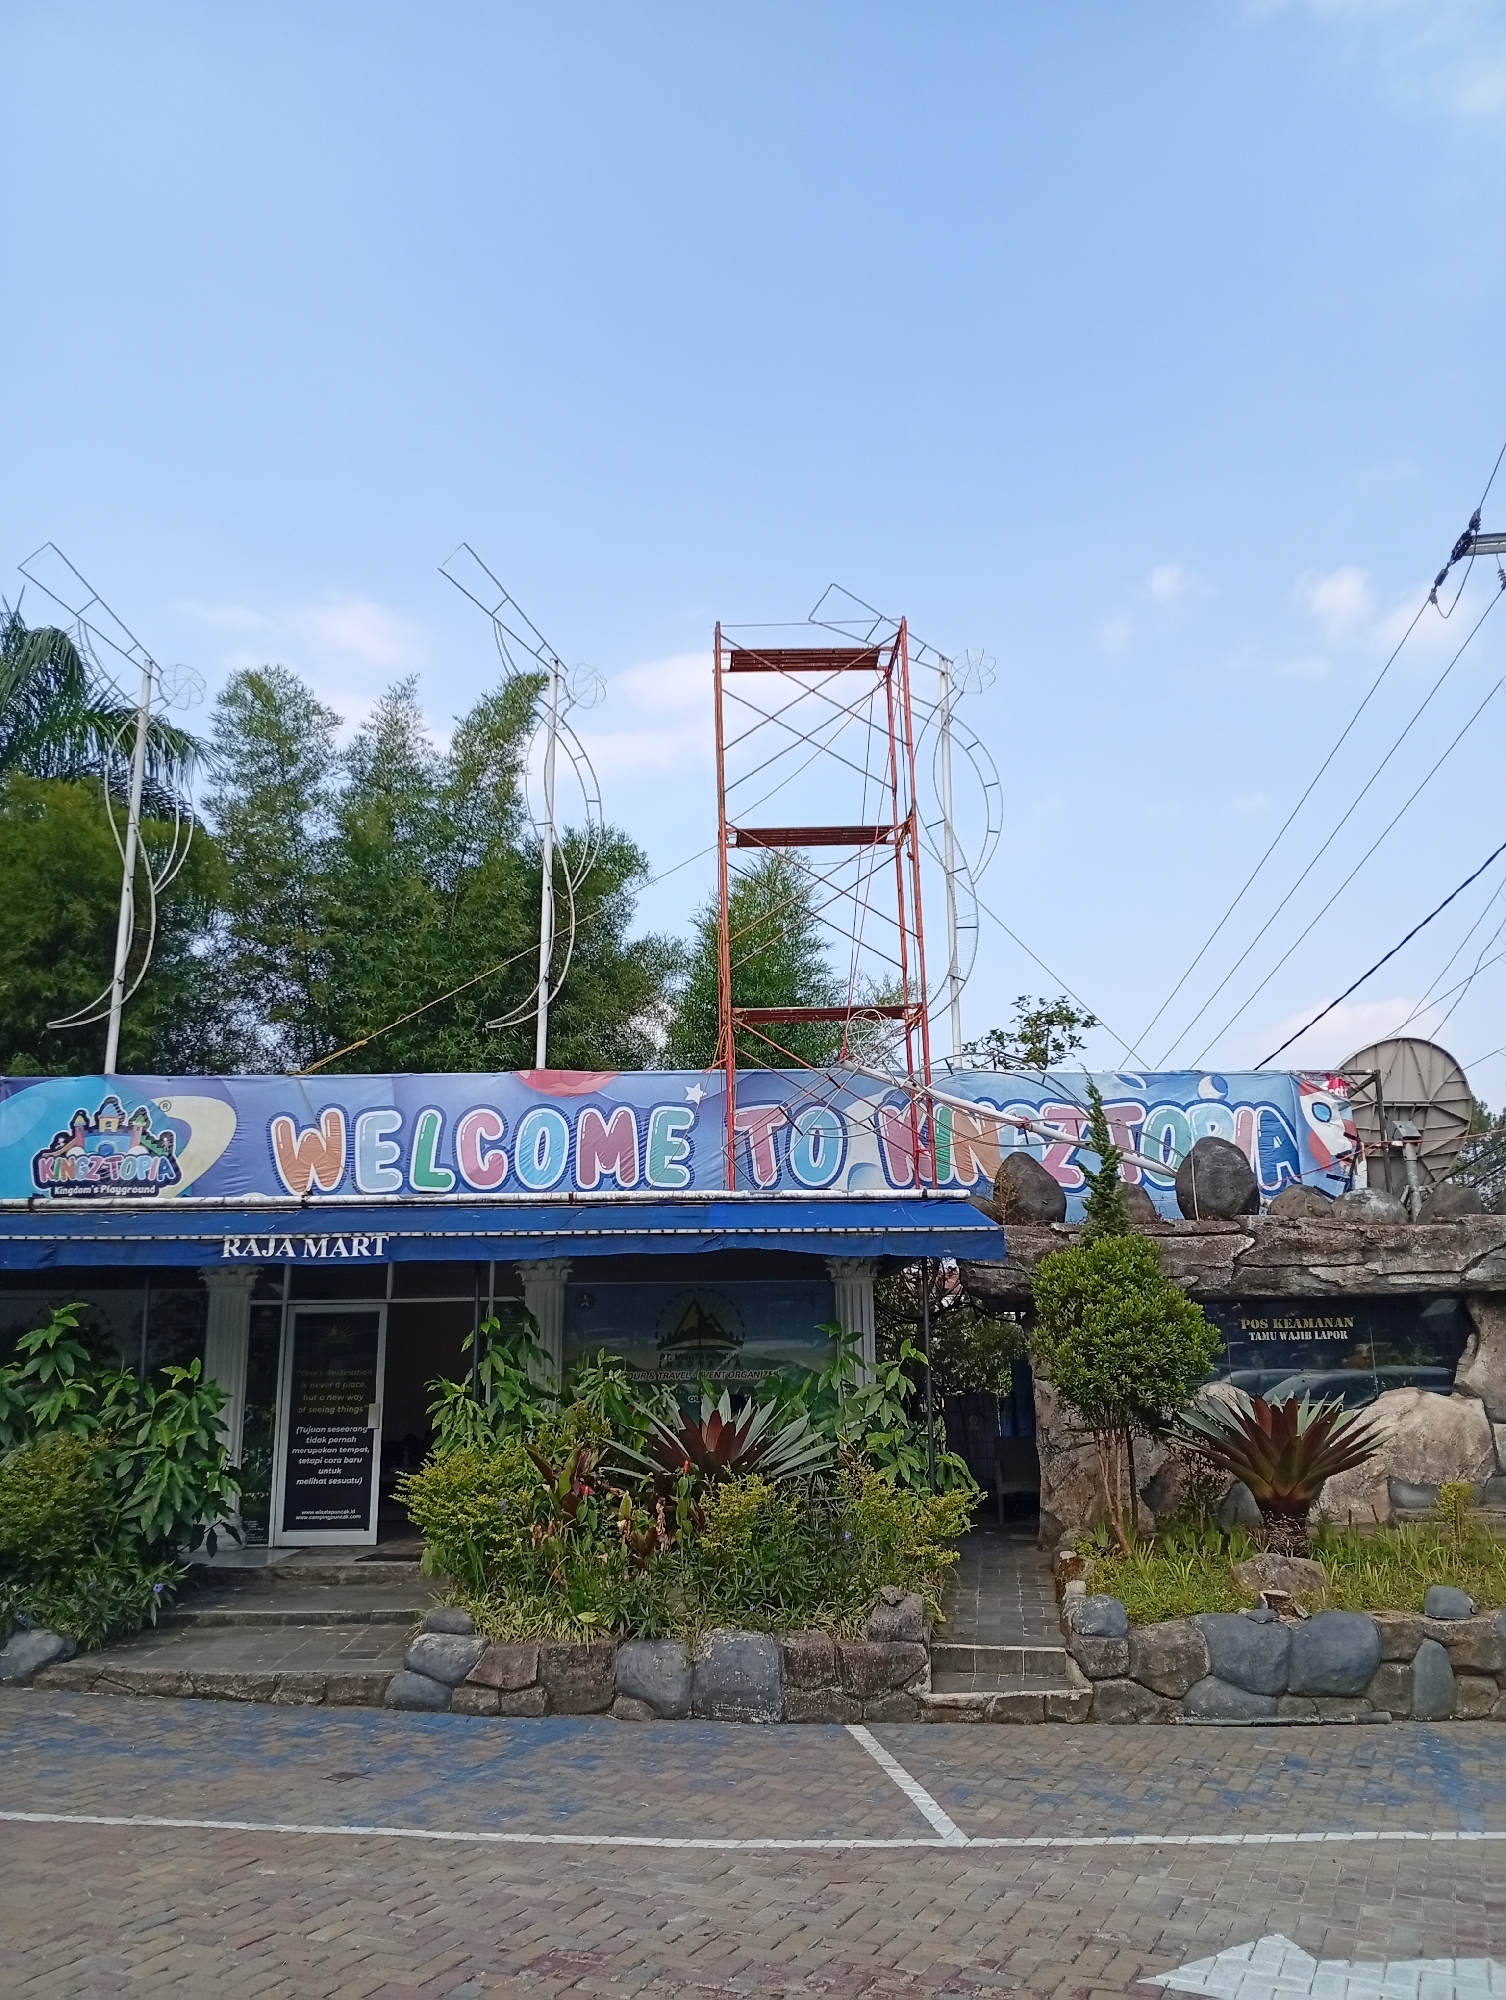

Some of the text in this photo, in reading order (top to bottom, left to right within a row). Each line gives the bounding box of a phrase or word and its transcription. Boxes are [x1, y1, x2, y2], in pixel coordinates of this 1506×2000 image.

[271, 1105, 695, 1195] WELCOME
[733, 1103, 846, 1188] TO
[38, 1155, 177, 1184] KINGZTOPIA
[54, 1184, 156, 1197] Kingdom's Playground
[221, 1235, 390, 1258] RAJA MART
[1240, 1316, 1354, 1330] POS KEAMANAN
[1249, 1330, 1349, 1341] TAMU WAJIB LAPOR
[706, 1352, 740, 1361] PUNCK
[623, 1371, 647, 1380] OUR
[658, 1370, 690, 1380] TRAVEL
[698, 1370, 725, 1379] VENT
[347, 1394, 364, 1402] way
[298, 1405, 307, 1414] of
[307, 1405, 335, 1414] seeing
[296, 1426, 368, 1434] (Tujuan seseorang
[306, 1436, 357, 1444] tidak pernah
[299, 1457, 323, 1465] tetapi
[317, 1467, 343, 1475] untuk
[295, 1477, 327, 1485] melihat
